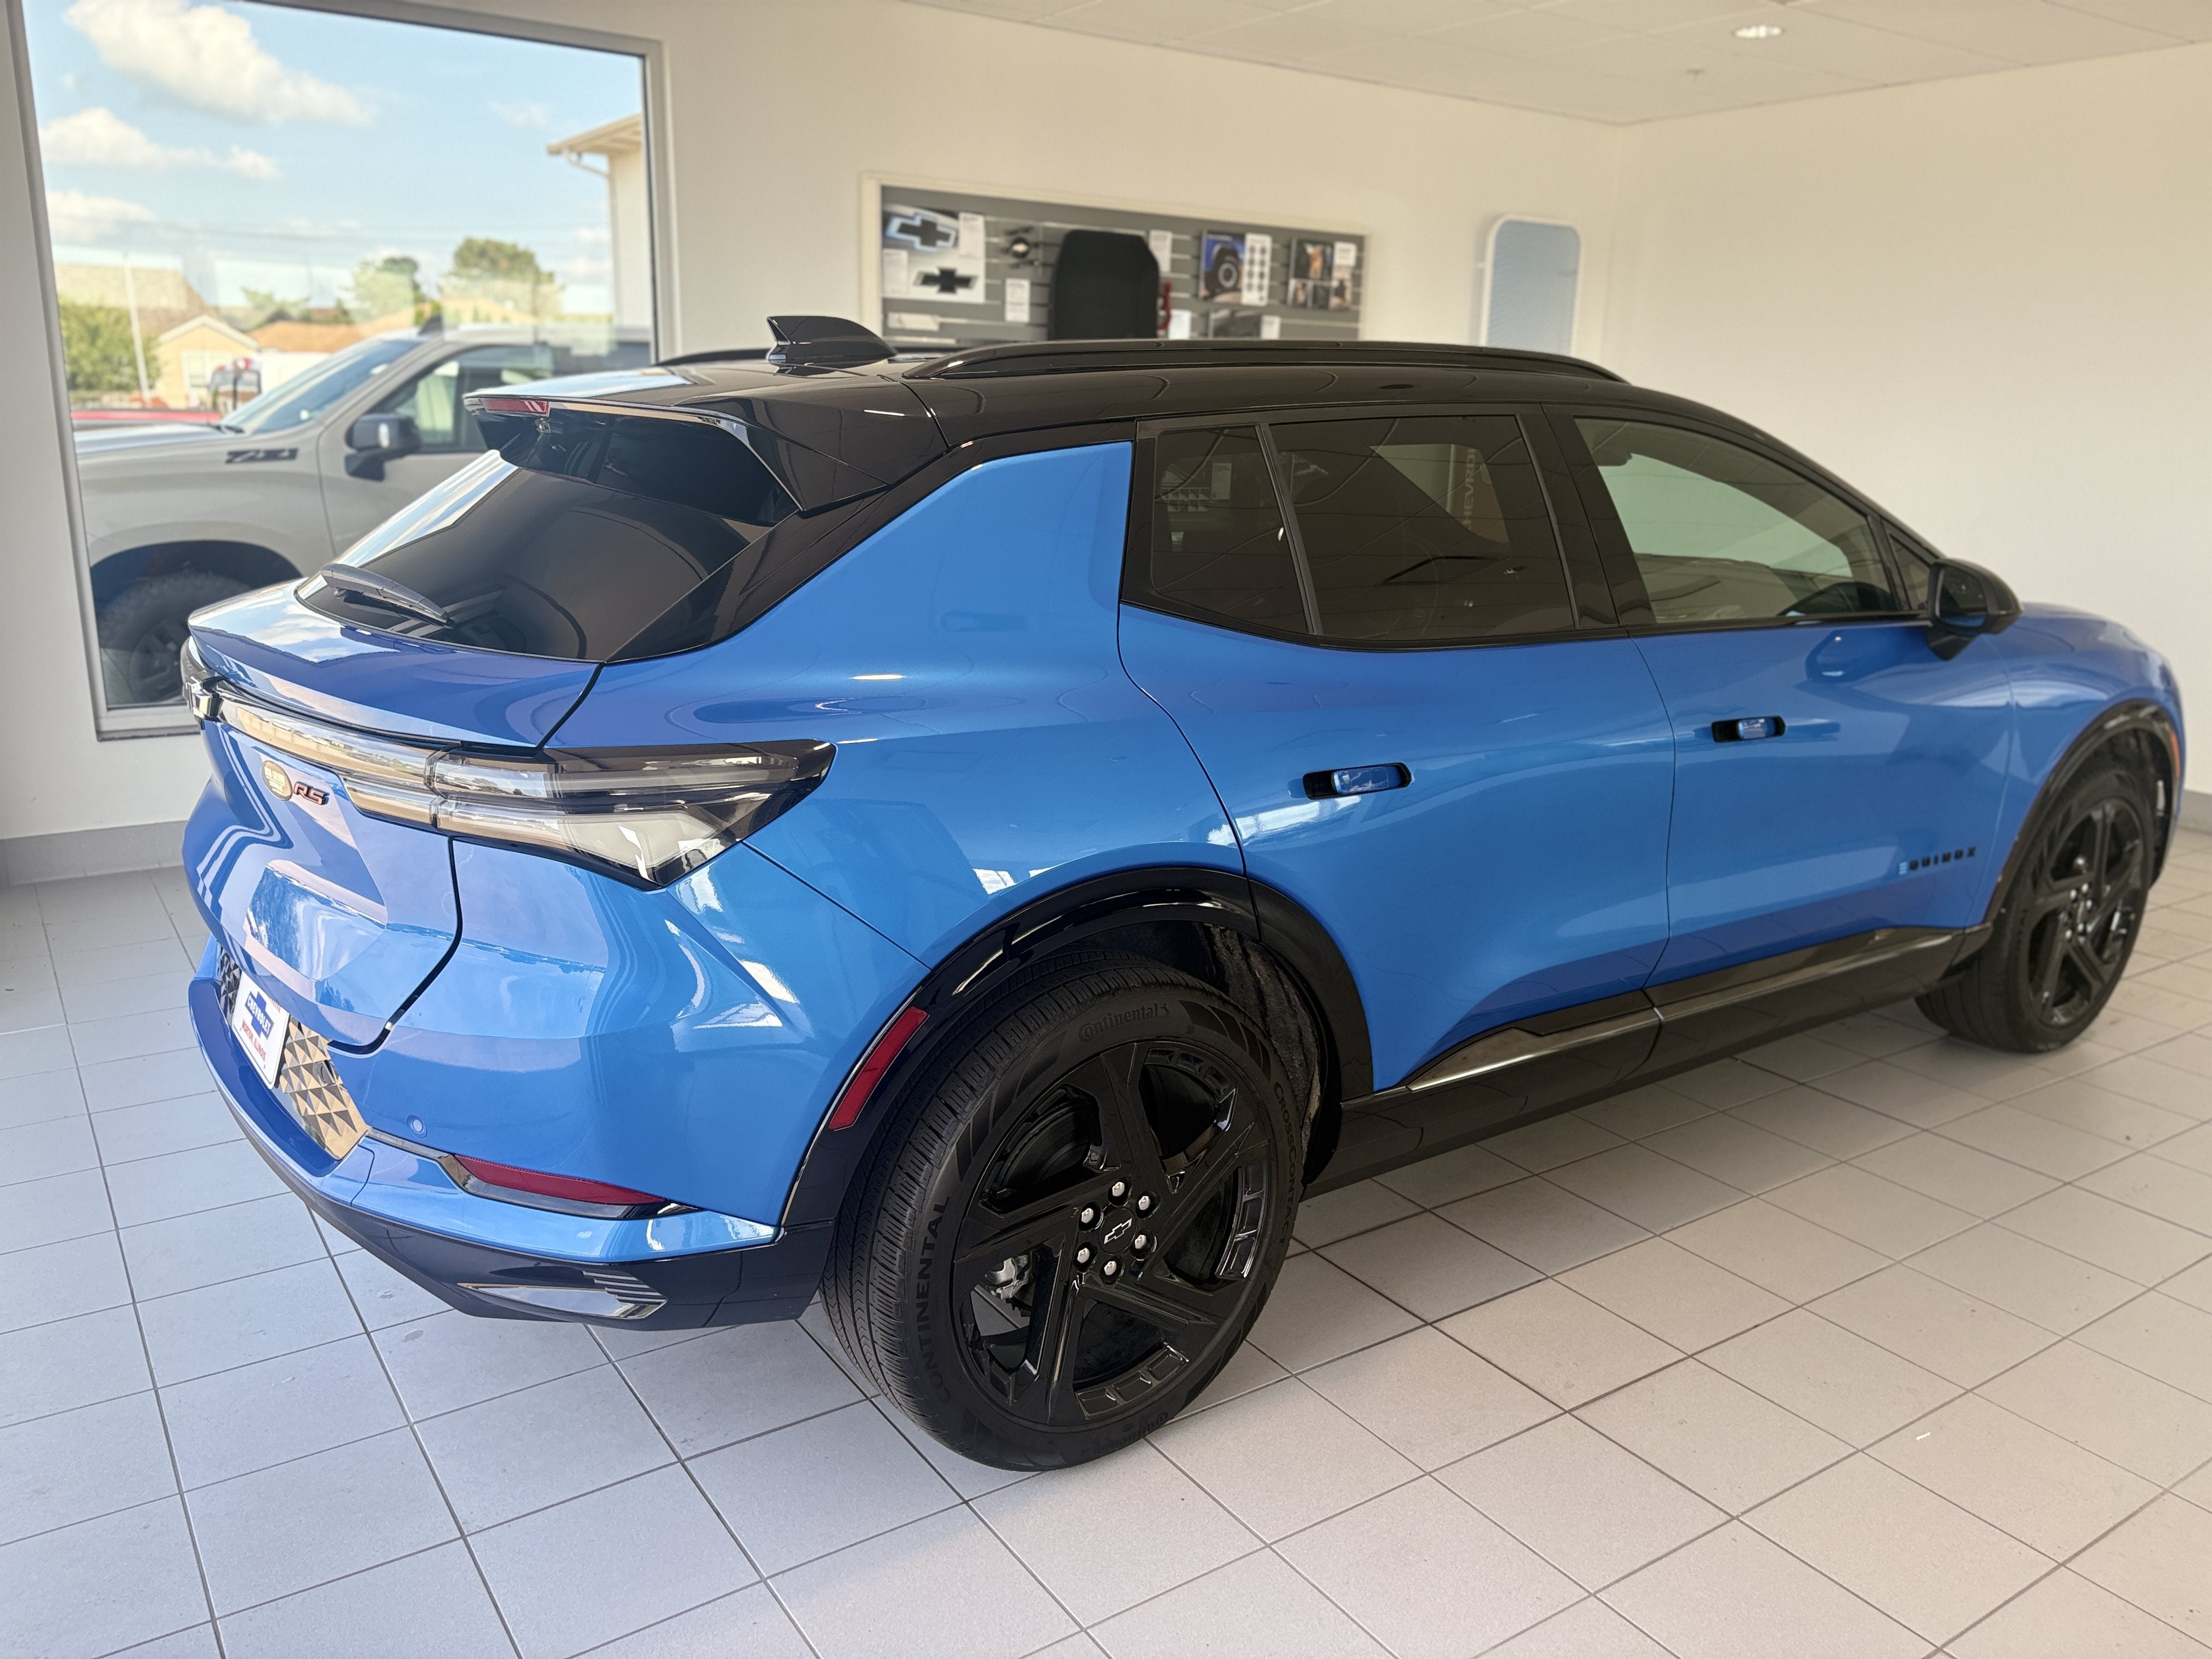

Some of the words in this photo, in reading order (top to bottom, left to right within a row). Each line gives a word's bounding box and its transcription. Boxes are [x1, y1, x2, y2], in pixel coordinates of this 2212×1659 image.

[294, 781, 327, 805] RS
[1899, 846, 1976, 876] EQUINOX
[247, 994, 272, 1035] CHEVROLET
[1079, 1003, 1158, 1042] Continental
[254, 1037, 267, 1062] ILLINOIS
[1273, 1082, 1296, 1246] CROSSCONTACT
[915, 1196, 951, 1403] CONTINENTAL
